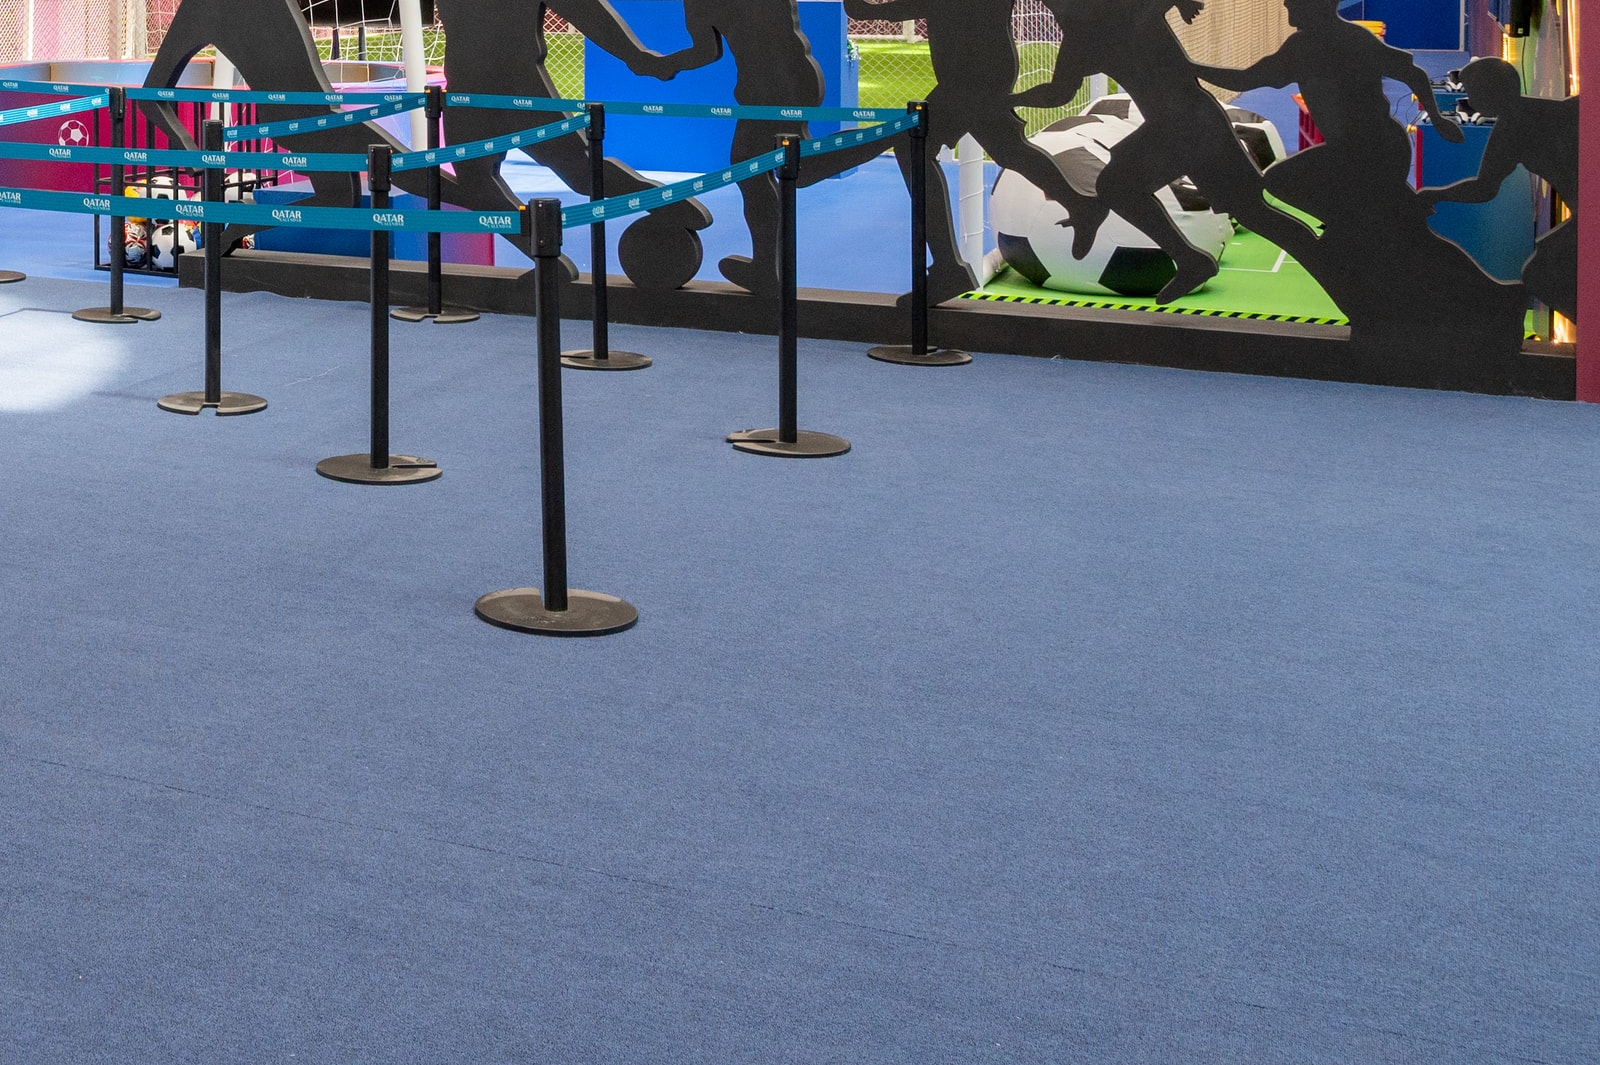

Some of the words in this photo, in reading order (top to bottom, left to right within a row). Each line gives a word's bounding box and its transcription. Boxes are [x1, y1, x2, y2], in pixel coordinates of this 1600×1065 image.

[49, 148, 71, 156] QATAR
[124, 152, 147, 160] QATAR
[202, 155, 226, 163] QATAR
[282, 157, 307, 166] QATAR
[84, 198, 110, 208] QATAR
[176, 204, 204, 214] QATAR
[272, 210, 302, 219] QATAR
[373, 214, 404, 223] QATAR
[479, 216, 511, 226] QATAR
